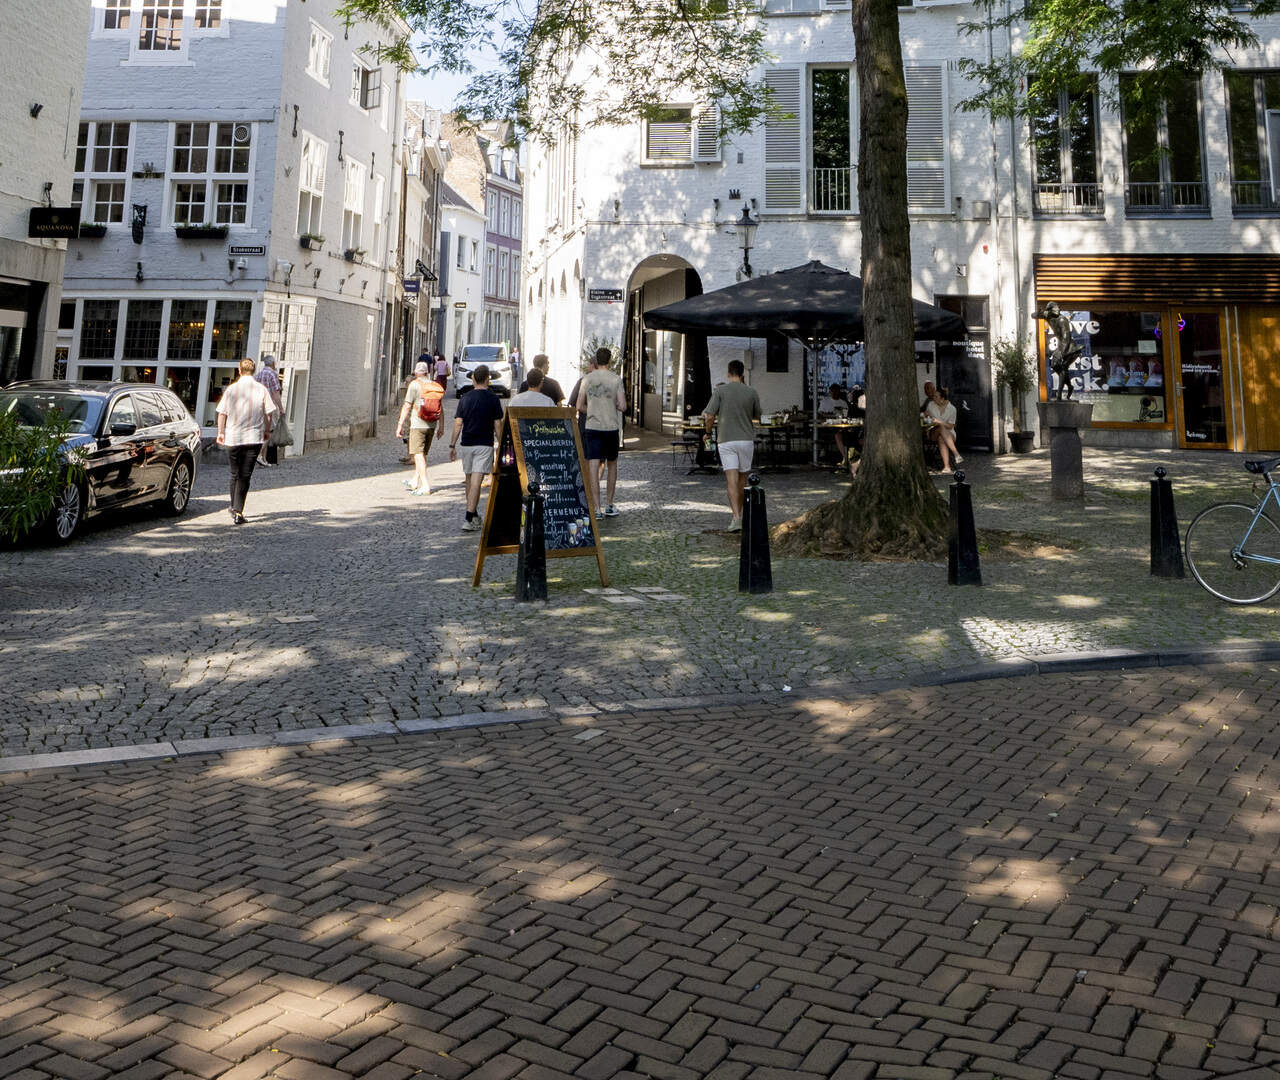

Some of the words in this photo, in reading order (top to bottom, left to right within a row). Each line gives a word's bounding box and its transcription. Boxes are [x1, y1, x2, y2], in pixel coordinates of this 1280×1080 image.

[36, 224, 74, 232] AQUANOVA
[1051, 371, 1109, 391] lck.
[523, 439, 574, 447] SPECIAALBIEREN
[544, 507, 585, 516] ERMENU'S
